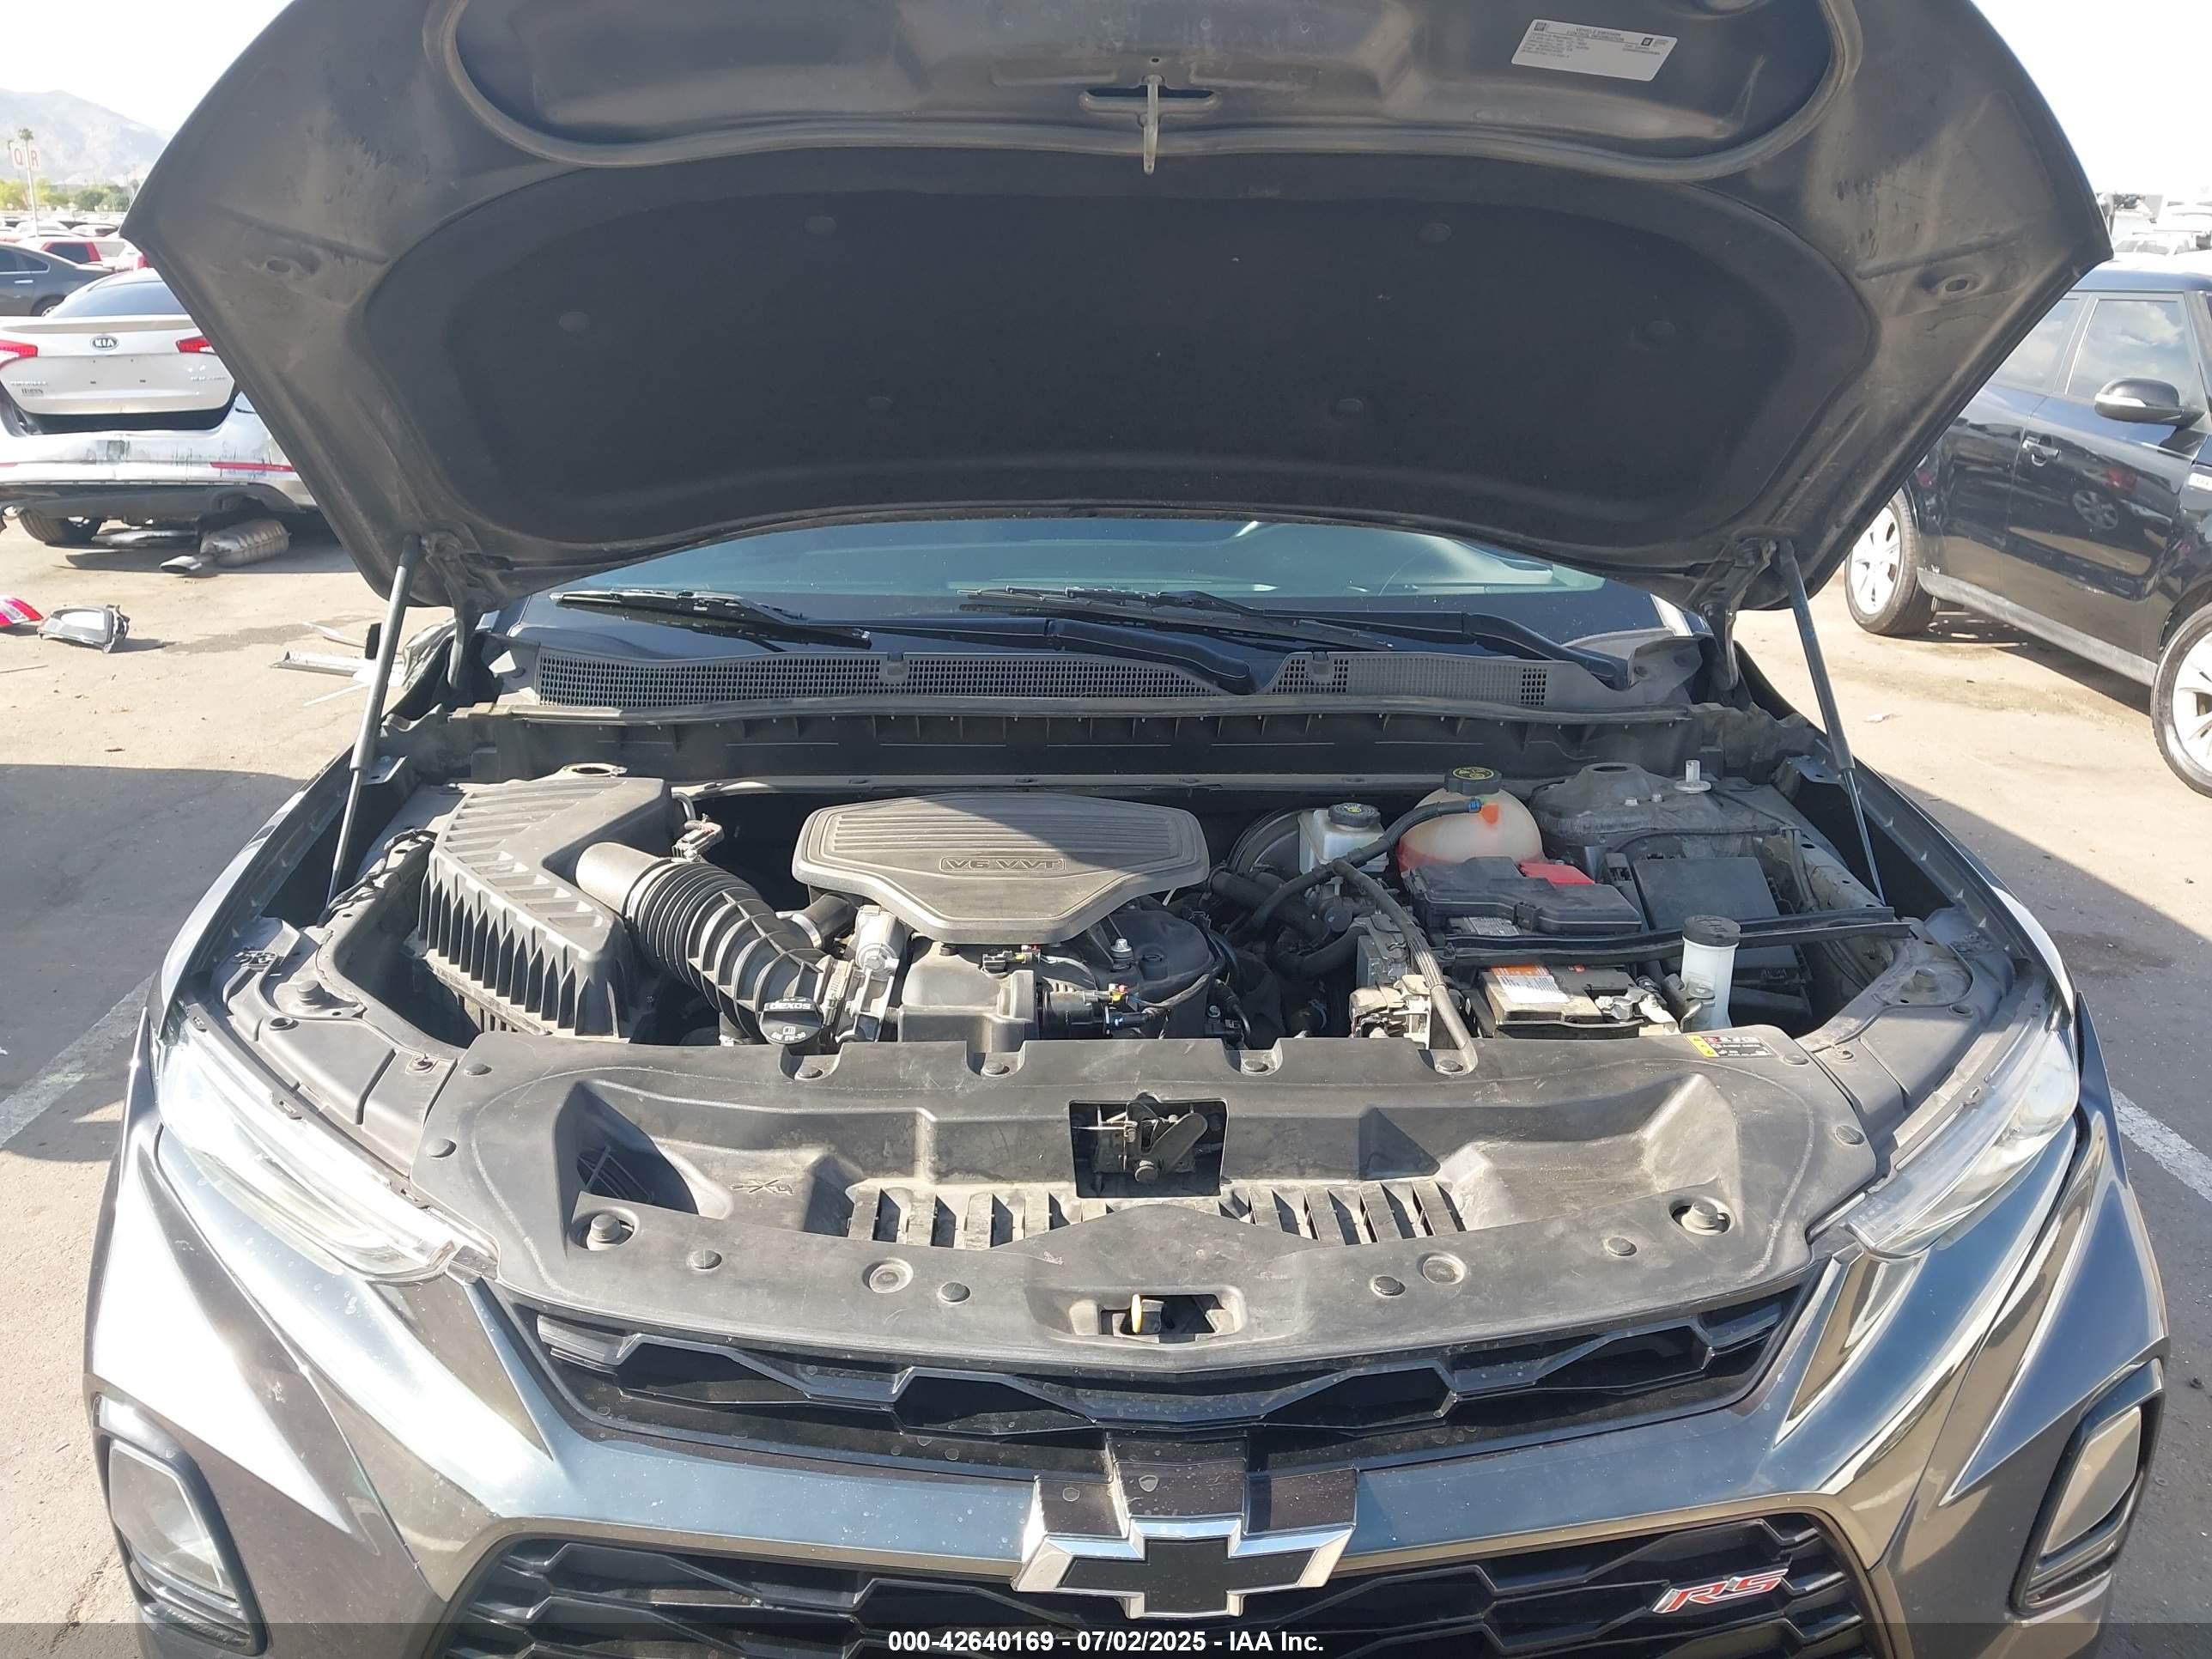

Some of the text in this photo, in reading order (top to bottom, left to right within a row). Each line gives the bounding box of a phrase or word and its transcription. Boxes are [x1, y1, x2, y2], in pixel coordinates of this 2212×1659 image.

[30, 150, 39, 166] R
[94, 338, 113, 348] KIA
[946, 859, 1060, 869] V6 VVT
[769, 1000, 811, 1010] dexos
[1652, 1569, 1789, 1613] RS
